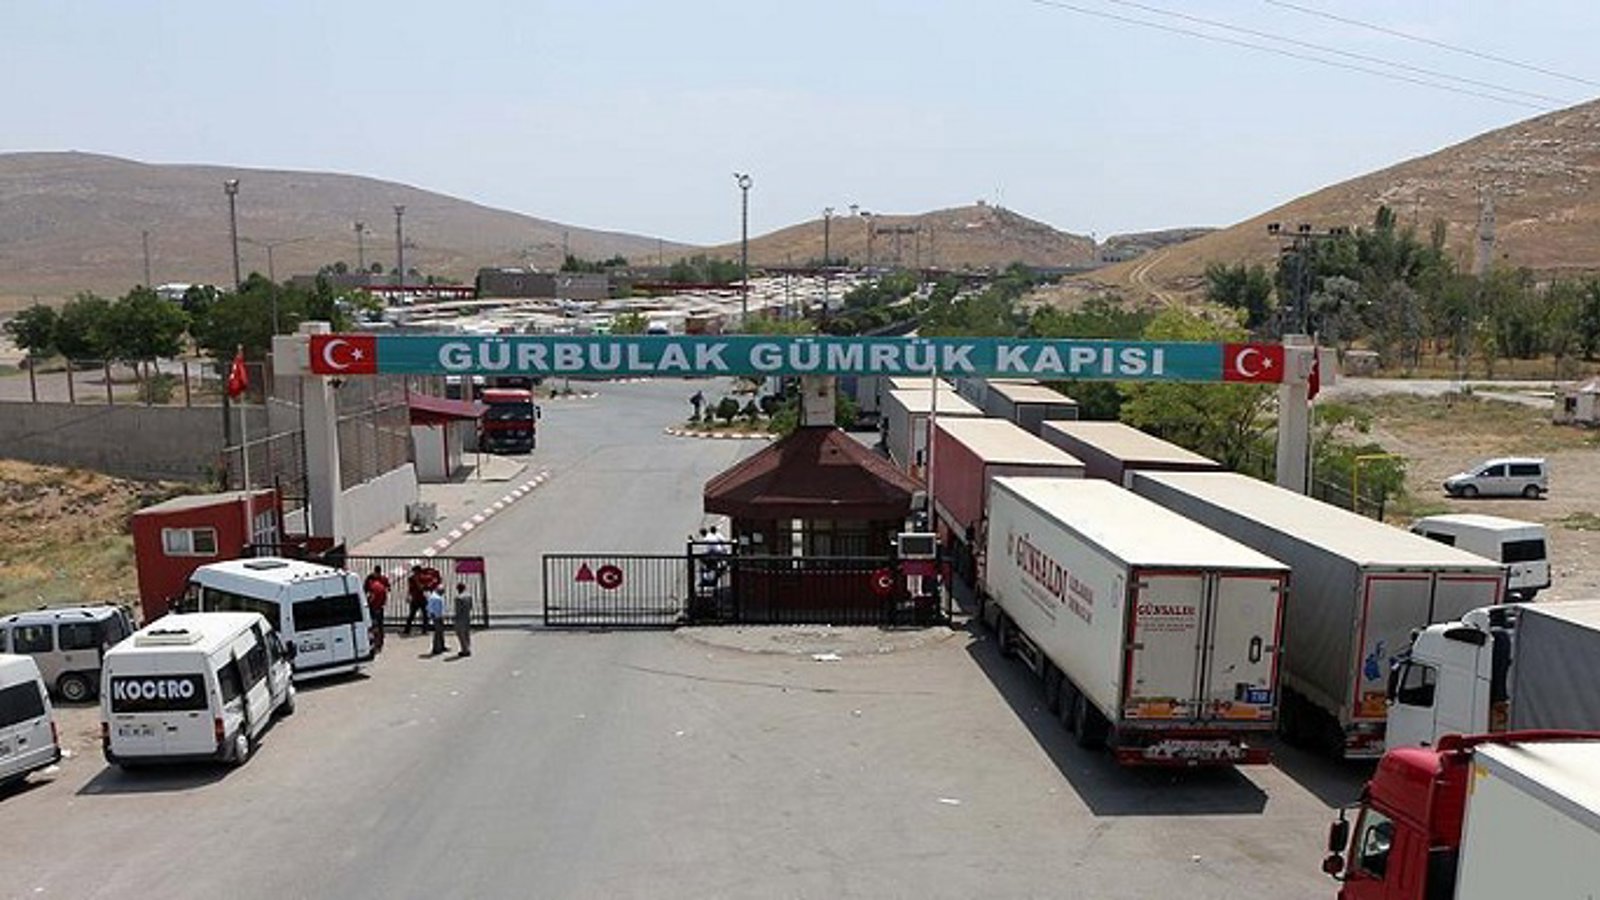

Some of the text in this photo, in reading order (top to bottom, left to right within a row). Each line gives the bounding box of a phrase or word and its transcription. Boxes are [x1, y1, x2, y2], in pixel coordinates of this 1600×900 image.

[438, 338, 1165, 375] GÜRBULAK GÜMRÜK KAPISI
